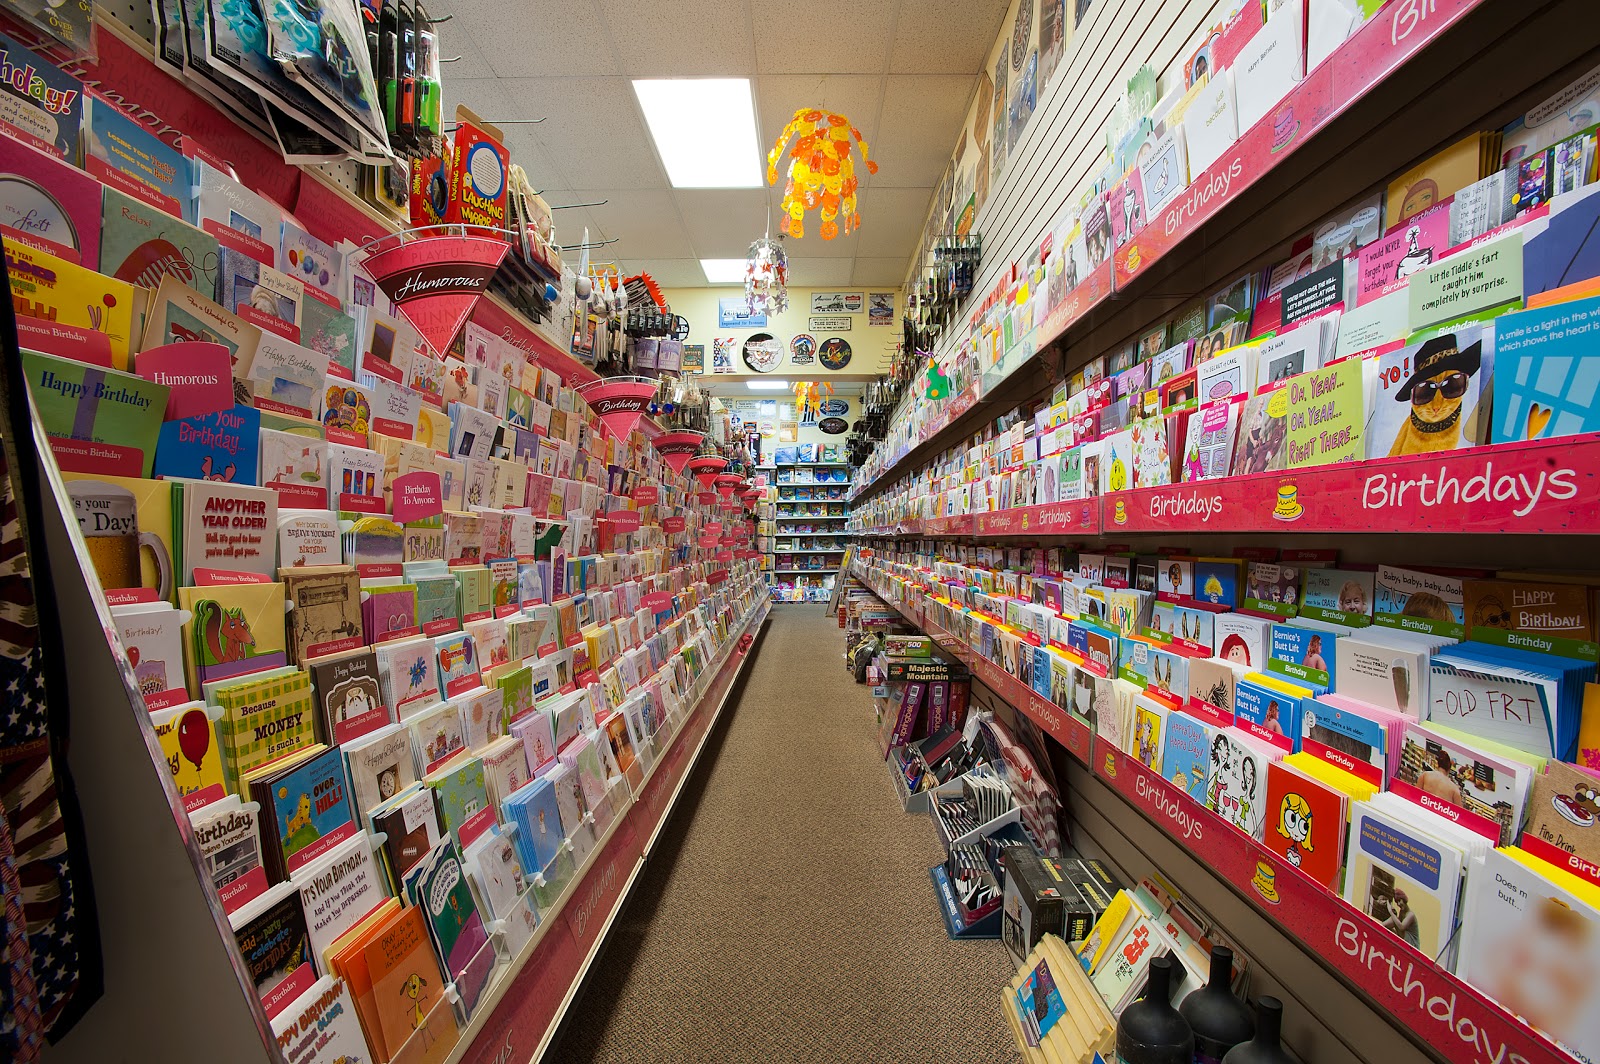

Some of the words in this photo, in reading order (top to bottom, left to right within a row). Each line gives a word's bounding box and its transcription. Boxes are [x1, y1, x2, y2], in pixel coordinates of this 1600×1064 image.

[1541, 100, 1555, 114] hope
[1574, 78, 1587, 93] long
[1553, 96, 1576, 112] another
[19, 115, 51, 133] celebrate
[111, 146, 135, 162] LOSING
[105, 168, 139, 191] Humorous
[140, 187, 165, 206] Birthday
[1165, 157, 1243, 237] Birthdays
[121, 206, 152, 228] Relax!
[217, 226, 245, 243] masculine
[245, 237, 265, 253] birthday
[1369, 247, 1384, 261] would
[1364, 264, 1382, 279] forget
[1382, 259, 1395, 274] your
[1429, 264, 1450, 284] Little
[1451, 259, 1480, 276] Tiddle's
[1481, 251, 1499, 266] fart
[395, 272, 484, 300] Humorous
[1442, 275, 1468, 292] caught
[1468, 271, 1484, 282] him
[1421, 288, 1460, 311] completely
[1461, 286, 1471, 299] by
[1471, 276, 1508, 295] surprise.
[204, 306, 228, 326] Wonderful
[272, 319, 293, 334] birthday
[1499, 333, 1505, 341] A
[1506, 327, 1524, 340] smile
[1526, 326, 1532, 334] is
[1532, 325, 1540, 333] a
[1541, 318, 1560, 332] light
[1562, 316, 1570, 324] in
[1571, 311, 1587, 322] the
[52, 328, 88, 343] Birthday
[501, 326, 541, 360] Birthday
[1499, 343, 1521, 353] which
[1521, 336, 1548, 348] shows
[1549, 331, 1564, 341] the
[1565, 325, 1592, 337] heart
[262, 345, 287, 367] Happy
[287, 354, 317, 376] Birthday
[154, 372, 218, 386] Humorous
[1379, 357, 1409, 389] YO!
[40, 370, 90, 399] Happy
[94, 381, 152, 412] Birthday
[1310, 371, 1344, 397] YEAH...
[600, 401, 642, 413] Birthday
[1308, 402, 1342, 428] YEAH...
[1319, 425, 1359, 455] THERE...
[90, 448, 122, 460] Birthday
[300, 487, 319, 498] birthday
[404, 485, 432, 496] Birthday
[1362, 461, 1578, 518] Birthdays
[84, 499, 111, 511] your
[204, 497, 266, 514] ANOTHER
[402, 496, 411, 505] To
[412, 496, 435, 505] Anyone
[1150, 490, 1223, 523] Birthdays
[93, 512, 137, 537] Day!
[202, 515, 230, 529] YEAR
[232, 516, 267, 529] OLDER!
[990, 516, 1012, 532] Birthdays
[1039, 508, 1072, 529] Birthdays
[287, 529, 310, 538] BEHAVE
[299, 545, 327, 554] BIRTHDAY
[210, 573, 238, 582] Humorous
[238, 574, 260, 584] Birthday
[1318, 578, 1330, 587] PASS
[1383, 570, 1401, 583] Baby,
[1402, 574, 1423, 588] baby,
[107, 594, 139, 603] Birthday
[1322, 599, 1336, 608] CRASS
[1512, 589, 1555, 606] HAPPY
[1258, 601, 1277, 613] Birthday
[1321, 610, 1347, 622] Birthday
[125, 625, 164, 638] Birthday!
[1401, 618, 1434, 633] Birthday
[1274, 630, 1301, 642] Bernice's
[1507, 634, 1553, 652] Birthday
[339, 640, 355, 651] birthday
[1274, 641, 1287, 651] Butt
[1288, 643, 1300, 653] Lift
[1279, 653, 1289, 662] was
[1372, 661, 1388, 670] really
[906, 673, 949, 681] Mountain
[908, 664, 948, 673] Majestic
[1284, 664, 1308, 679] Birthday
[1158, 688, 1173, 700] Birthday
[1236, 688, 1261, 706] Bernice's
[240, 699, 277, 717] Because
[1029, 696, 1061, 732] Birthdays
[1202, 704, 1220, 718] Birthday
[1236, 698, 1249, 709] Butt
[1249, 703, 1260, 715] Lift
[1486, 690, 1536, 724] FRT
[367, 709, 383, 724] birthday
[253, 711, 304, 743] MONEY
[1251, 725, 1273, 740] Birthday
[267, 745, 276, 755] is
[276, 739, 295, 752] such
[295, 736, 302, 744] a
[1169, 735, 1188, 751] Happy
[1326, 750, 1354, 770] Birthday
[314, 784, 343, 816] HILL!
[1135, 774, 1203, 841] Birthdays
[1421, 795, 1460, 821] Birthday
[1538, 823, 1555, 845] Fine
[301, 842, 325, 862] Humorous
[325, 831, 345, 850] Birthday
[1362, 830, 1376, 841] KNOW
[1381, 840, 1392, 849] NEW
[1392, 845, 1408, 858] DRESS
[1408, 854, 1423, 865] CAN'T
[1423, 862, 1438, 874] MAKE
[1365, 823, 1380, 835] YOU'RE
[1387, 834, 1400, 844] THAT
[1400, 841, 1410, 849] AGE
[1410, 845, 1426, 858] WHEN
[1426, 853, 1437, 864] YOU
[1384, 850, 1393, 859] YOU
[221, 881, 248, 902] Birthday
[301, 882, 316, 907] IT'S
[312, 871, 334, 898] YOUR
[1495, 873, 1517, 893] Does
[314, 903, 325, 917] And
[330, 892, 341, 905] You
[354, 871, 366, 888] That
[1498, 889, 1523, 912] butt...
[271, 980, 297, 1004] Birthday
[299, 980, 343, 1032] BIRTHDAY
